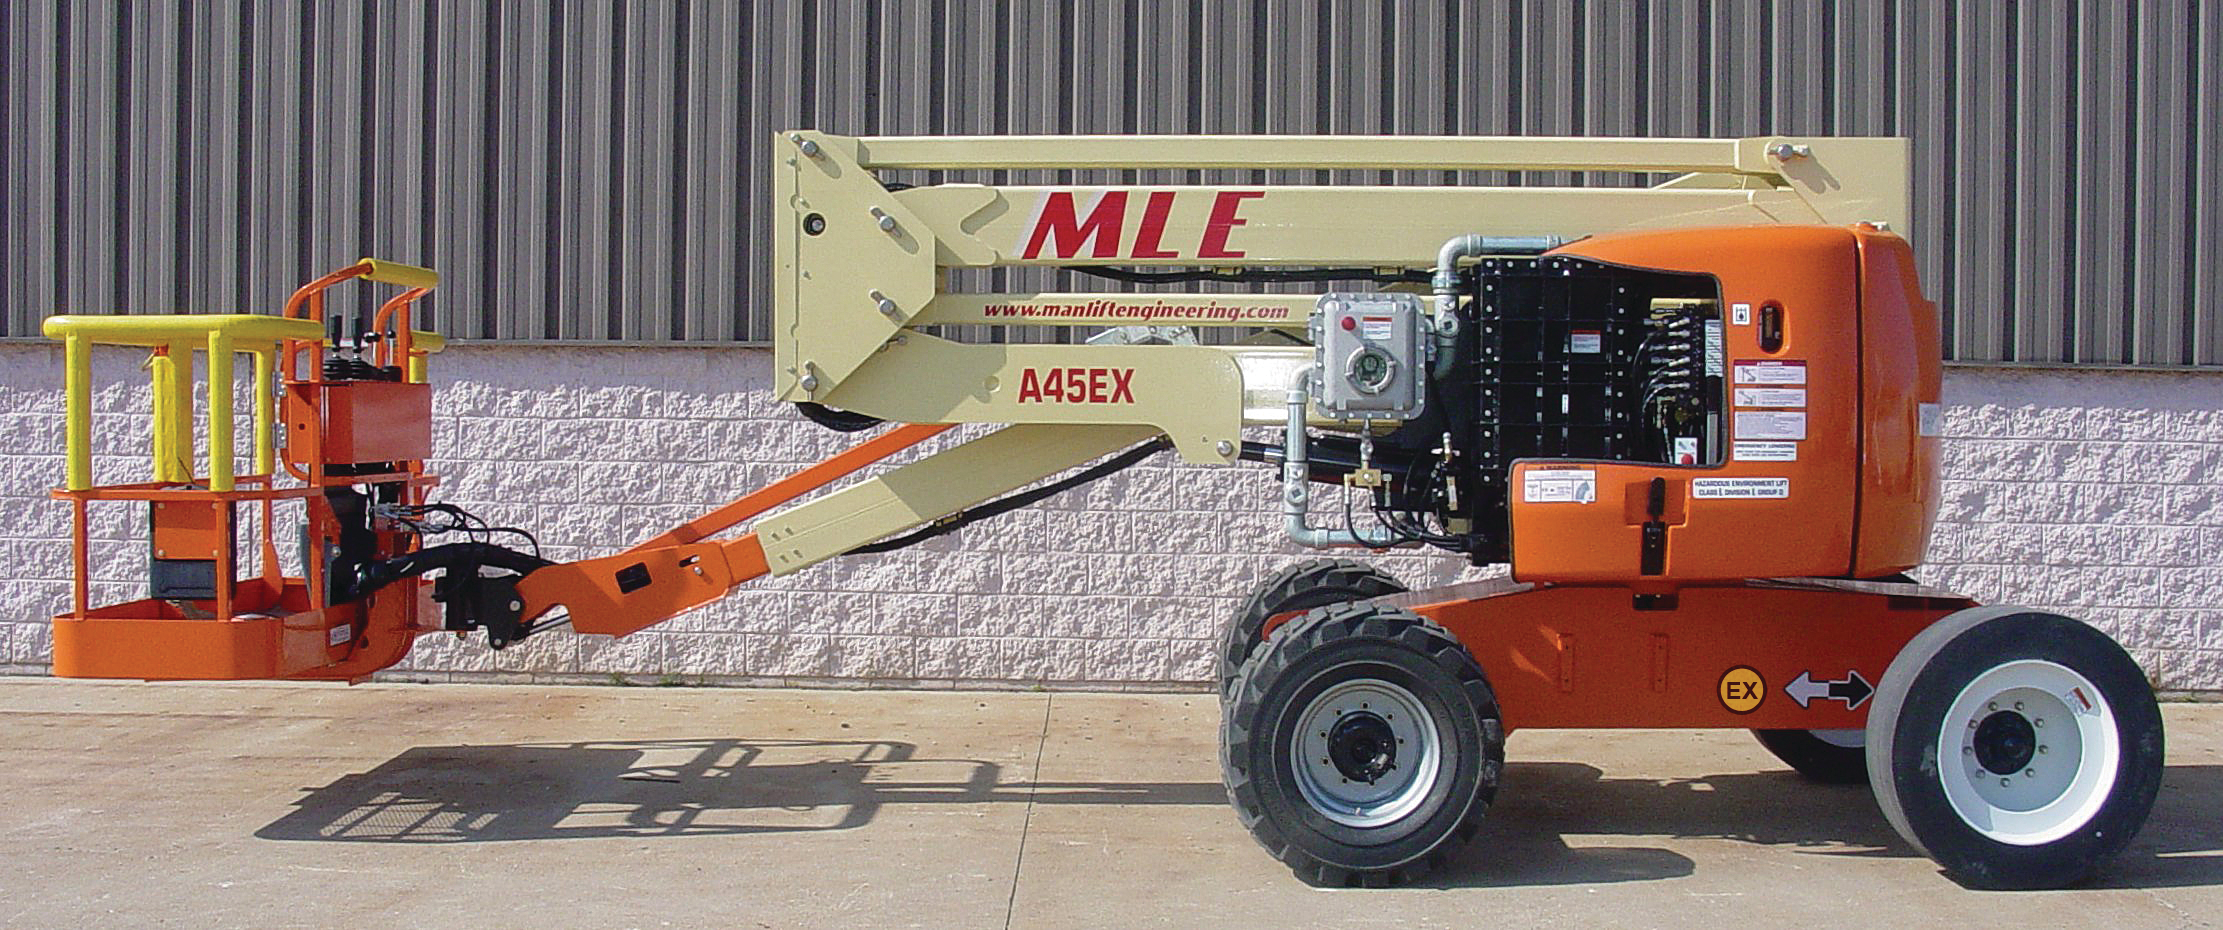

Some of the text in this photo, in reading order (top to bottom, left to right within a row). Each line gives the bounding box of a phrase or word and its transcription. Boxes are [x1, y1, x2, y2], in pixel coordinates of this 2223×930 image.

[1021, 190, 1266, 260] MLE
[984, 300, 1289, 321] www.manliftengineering.com
[1018, 368, 1135, 404] A45EX
[1727, 681, 1758, 699] EX
